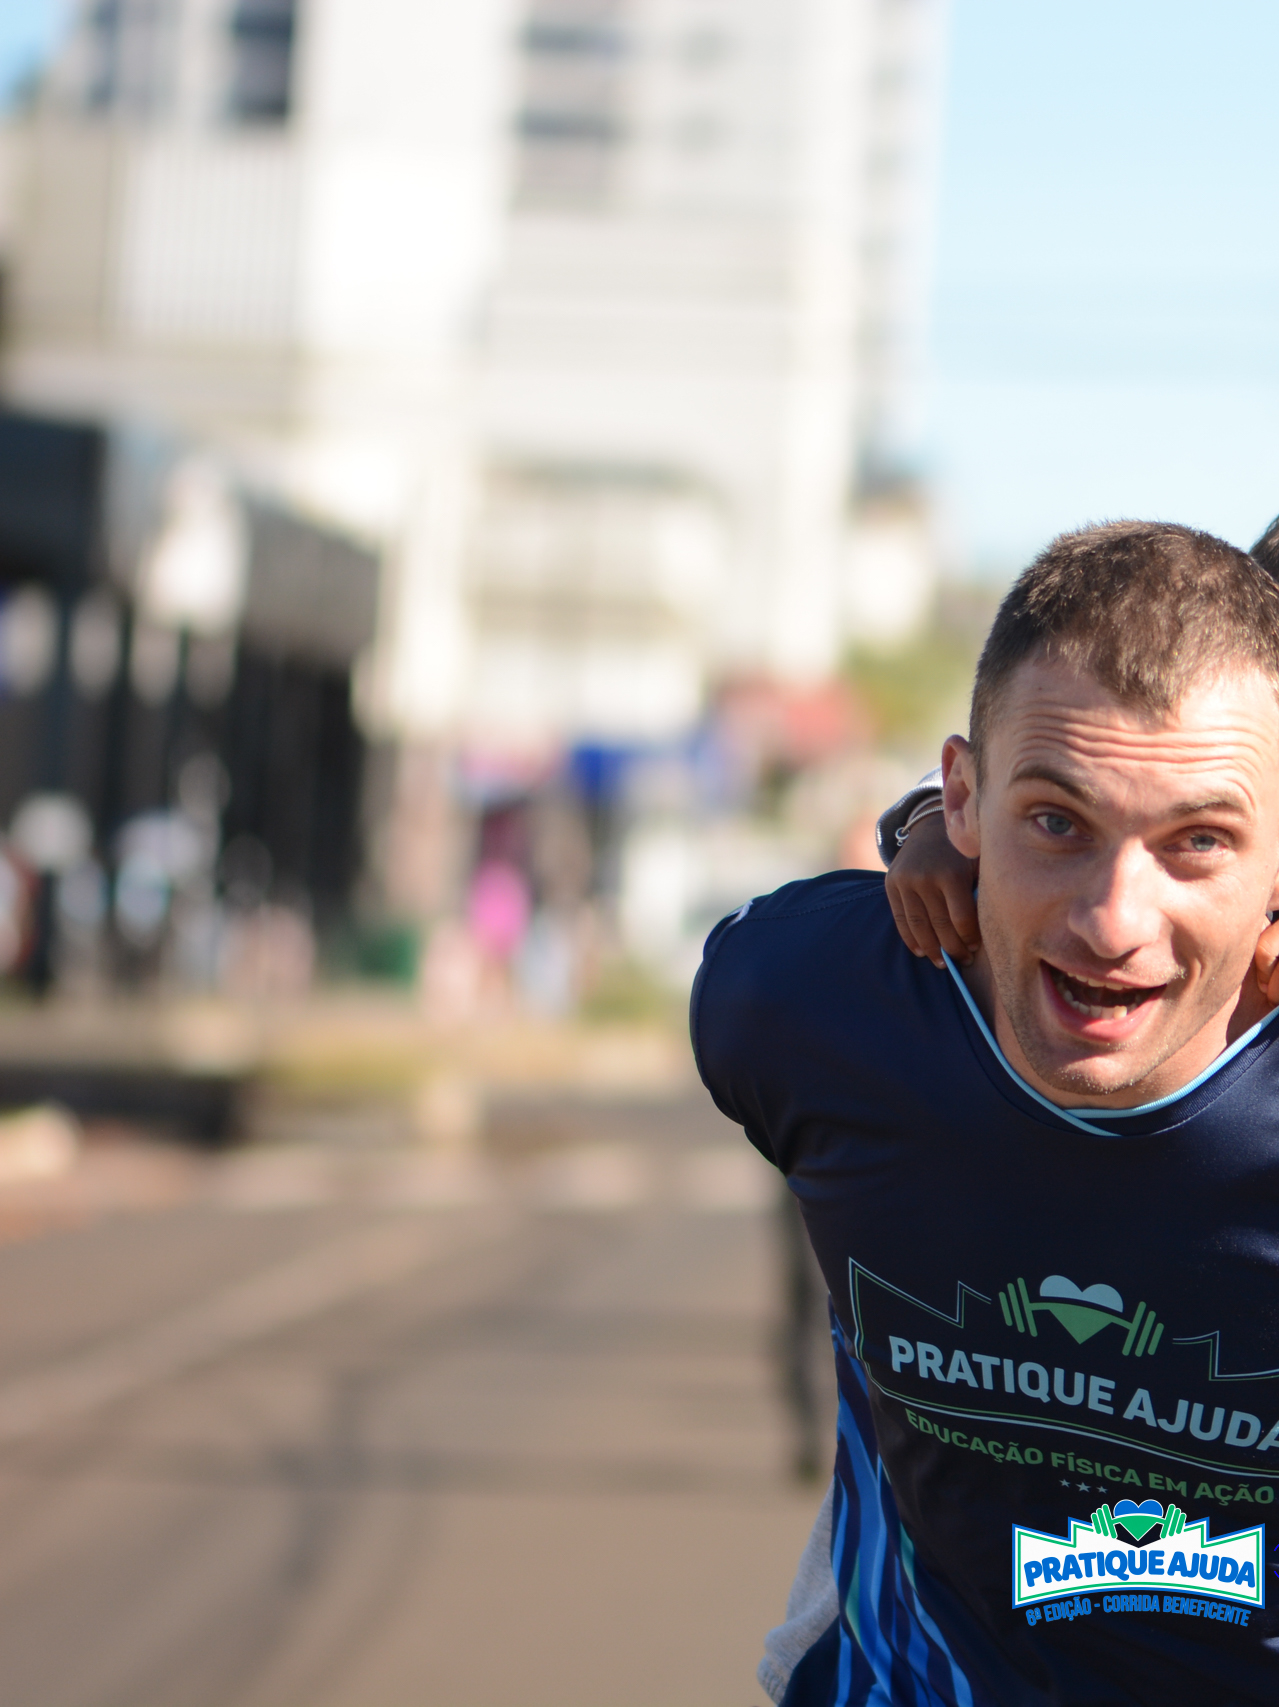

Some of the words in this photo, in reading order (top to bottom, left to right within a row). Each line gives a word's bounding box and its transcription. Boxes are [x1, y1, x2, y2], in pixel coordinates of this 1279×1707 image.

[889, 1335, 1115, 1415] PRATIQUE
[904, 1407, 1044, 1465] EDUCAÇÃO
[1051, 1451, 1143, 1488] FÍSICA
[1148, 1472, 1188, 1498] EM
[1193, 1483, 1275, 1506] AÇÃO
